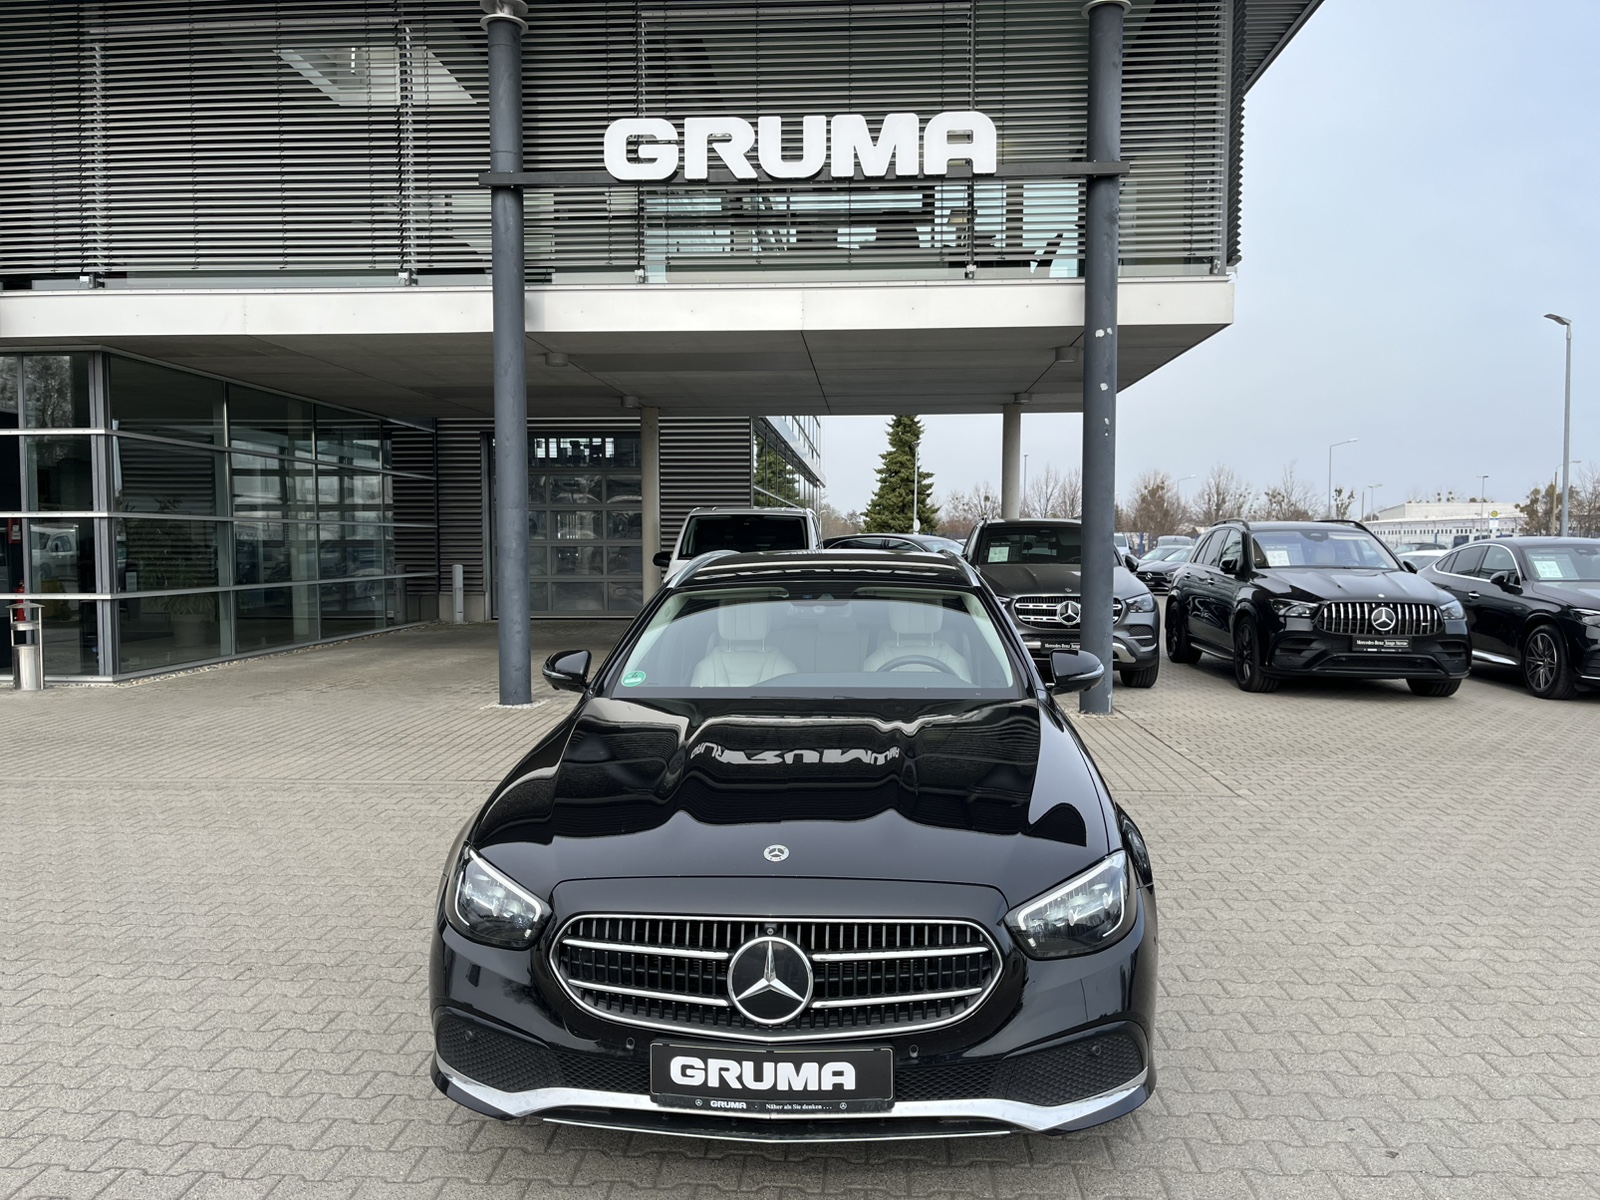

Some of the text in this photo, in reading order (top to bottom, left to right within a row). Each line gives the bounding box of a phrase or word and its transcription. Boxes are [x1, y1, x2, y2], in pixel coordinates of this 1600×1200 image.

[603, 111, 997, 181] GRUMA
[670, 1056, 856, 1091] GRUMA
[710, 1100, 747, 1109] GRUMA
